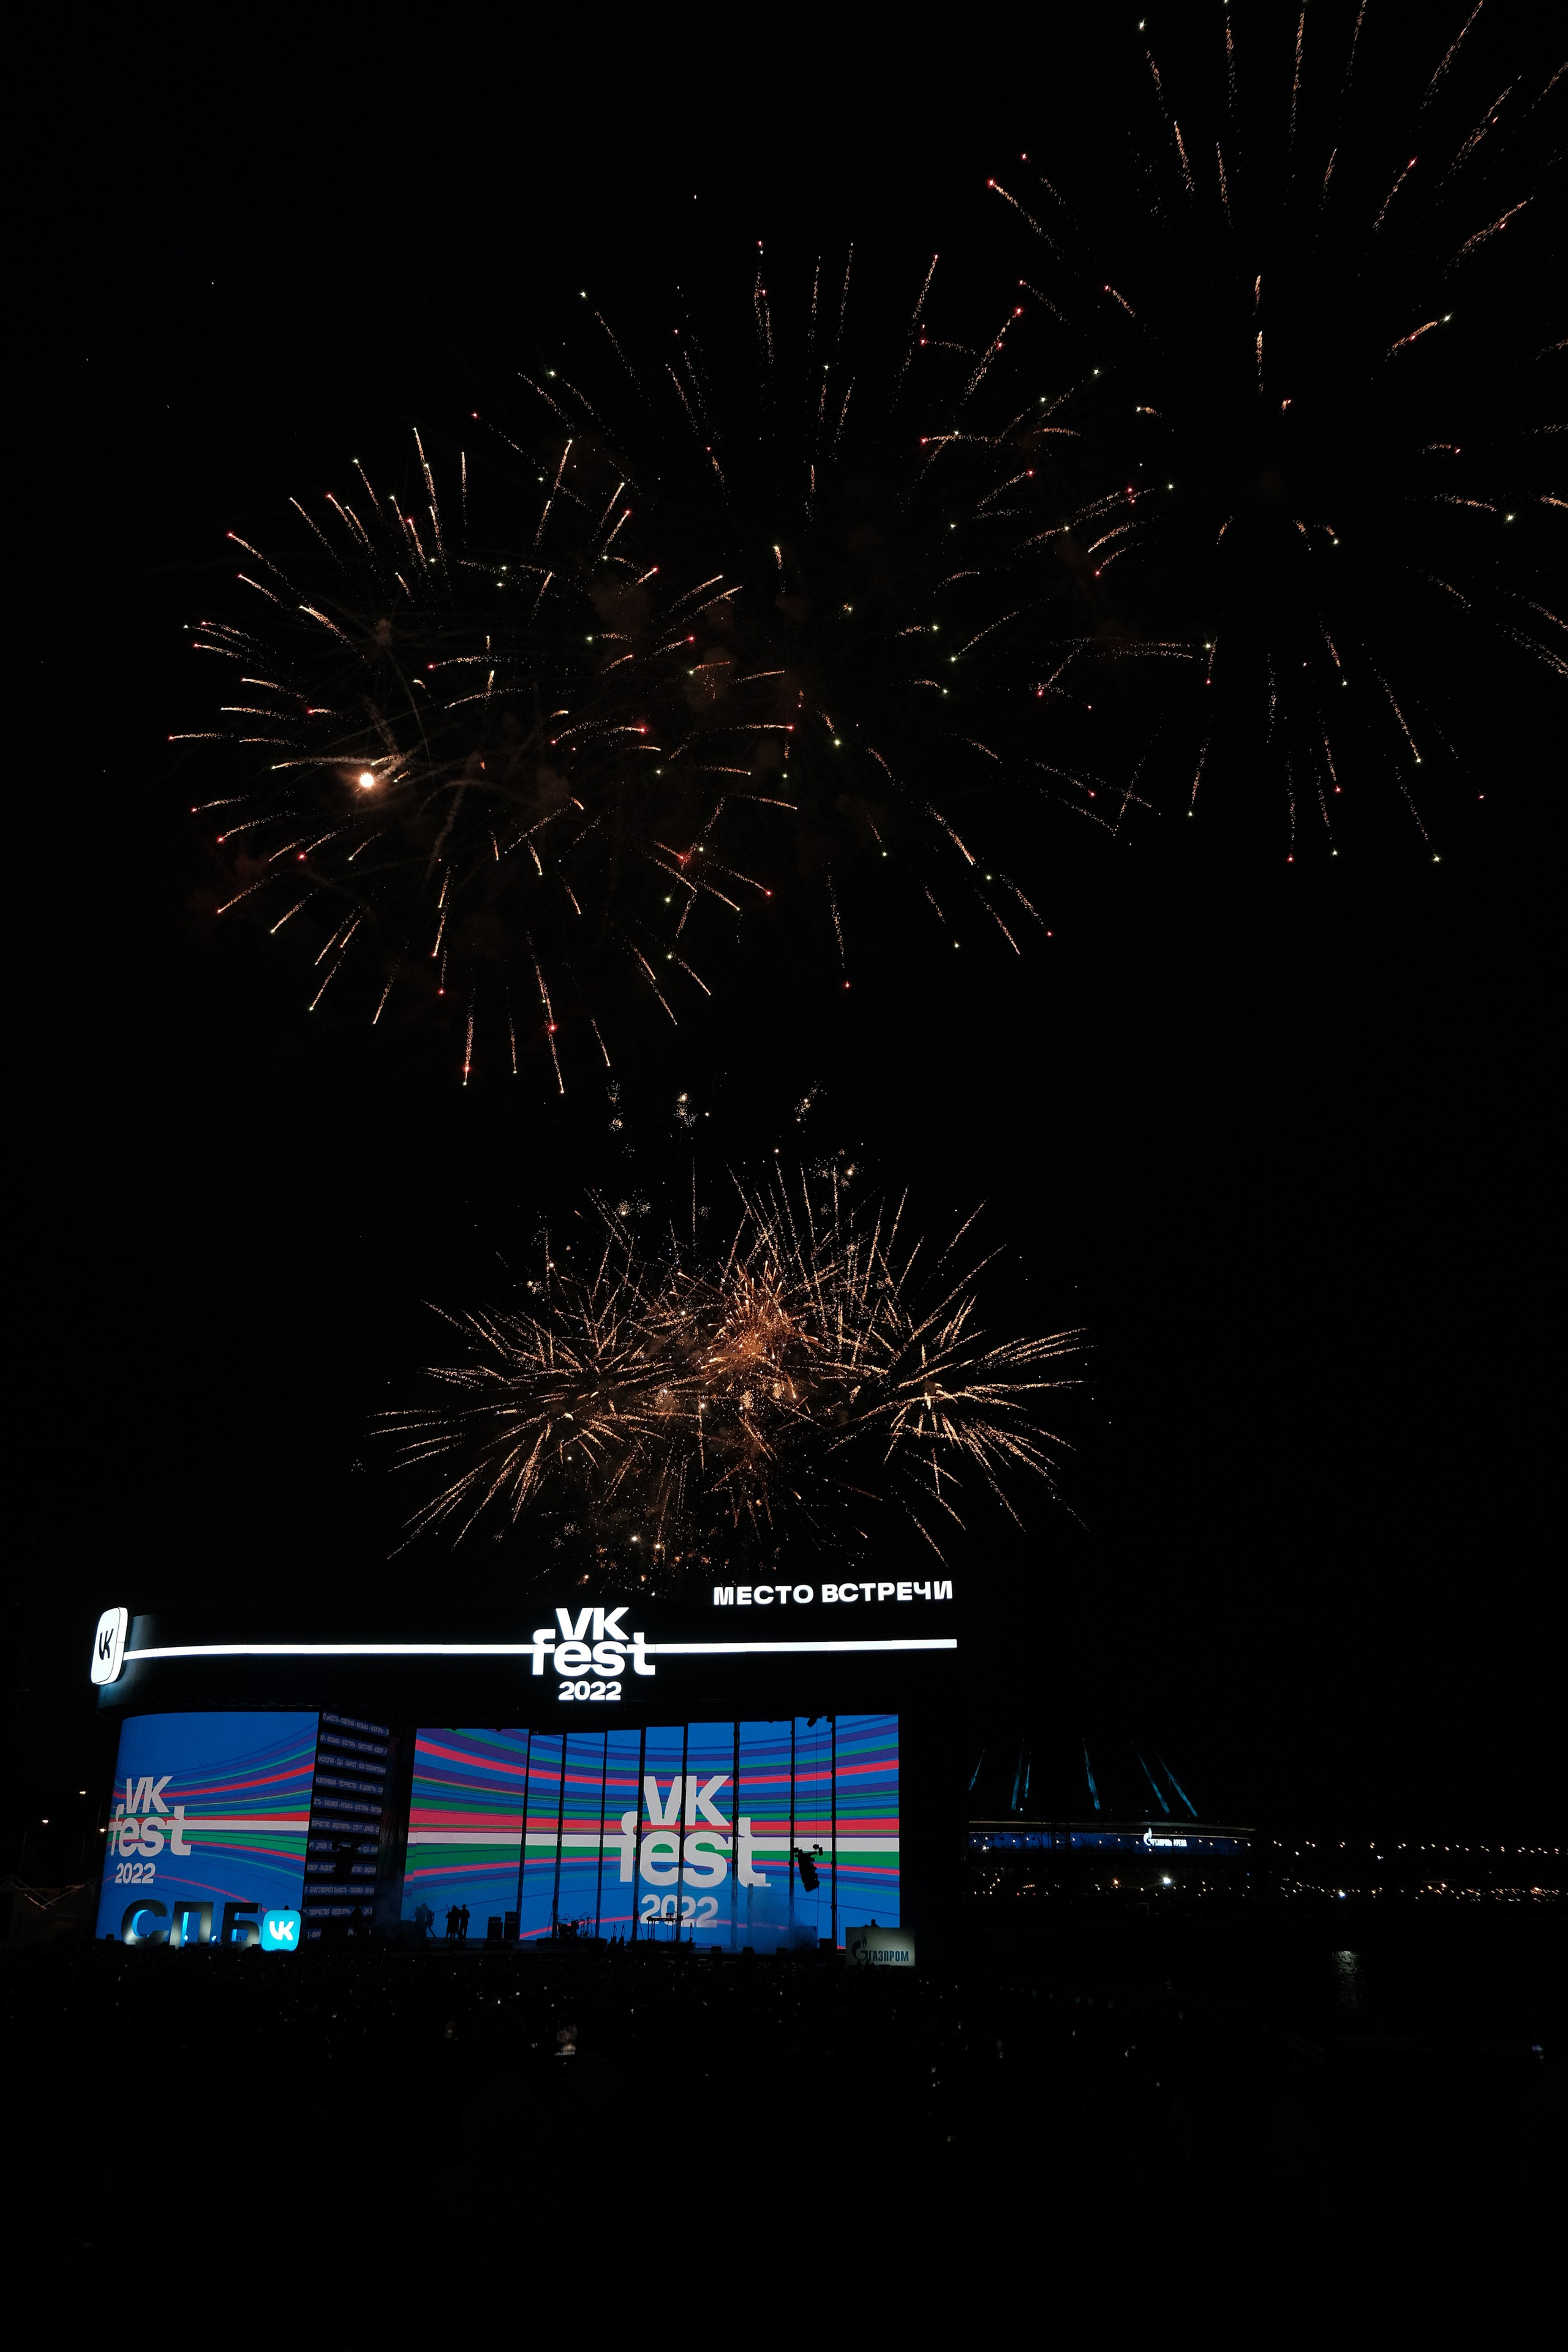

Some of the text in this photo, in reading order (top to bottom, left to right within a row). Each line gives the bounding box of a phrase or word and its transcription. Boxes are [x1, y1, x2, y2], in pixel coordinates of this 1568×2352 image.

[713, 1580, 954, 1606] МЕСТО ВСТРЕЧИ
[555, 1607, 630, 1641] VK
[532, 1628, 656, 1677] fest
[557, 1680, 622, 1702] 2022
[126, 1776, 173, 1814] VK
[643, 1774, 731, 1826] VK
[110, 1804, 192, 1857] fest
[619, 1811, 772, 1888] fest
[115, 1862, 156, 1885] 2022
[121, 1898, 262, 1949] СПБ
[639, 1893, 718, 1929] 2022
[270, 1920, 295, 1941] VK
[867, 1949, 910, 1963] ГАЗПРОМ
